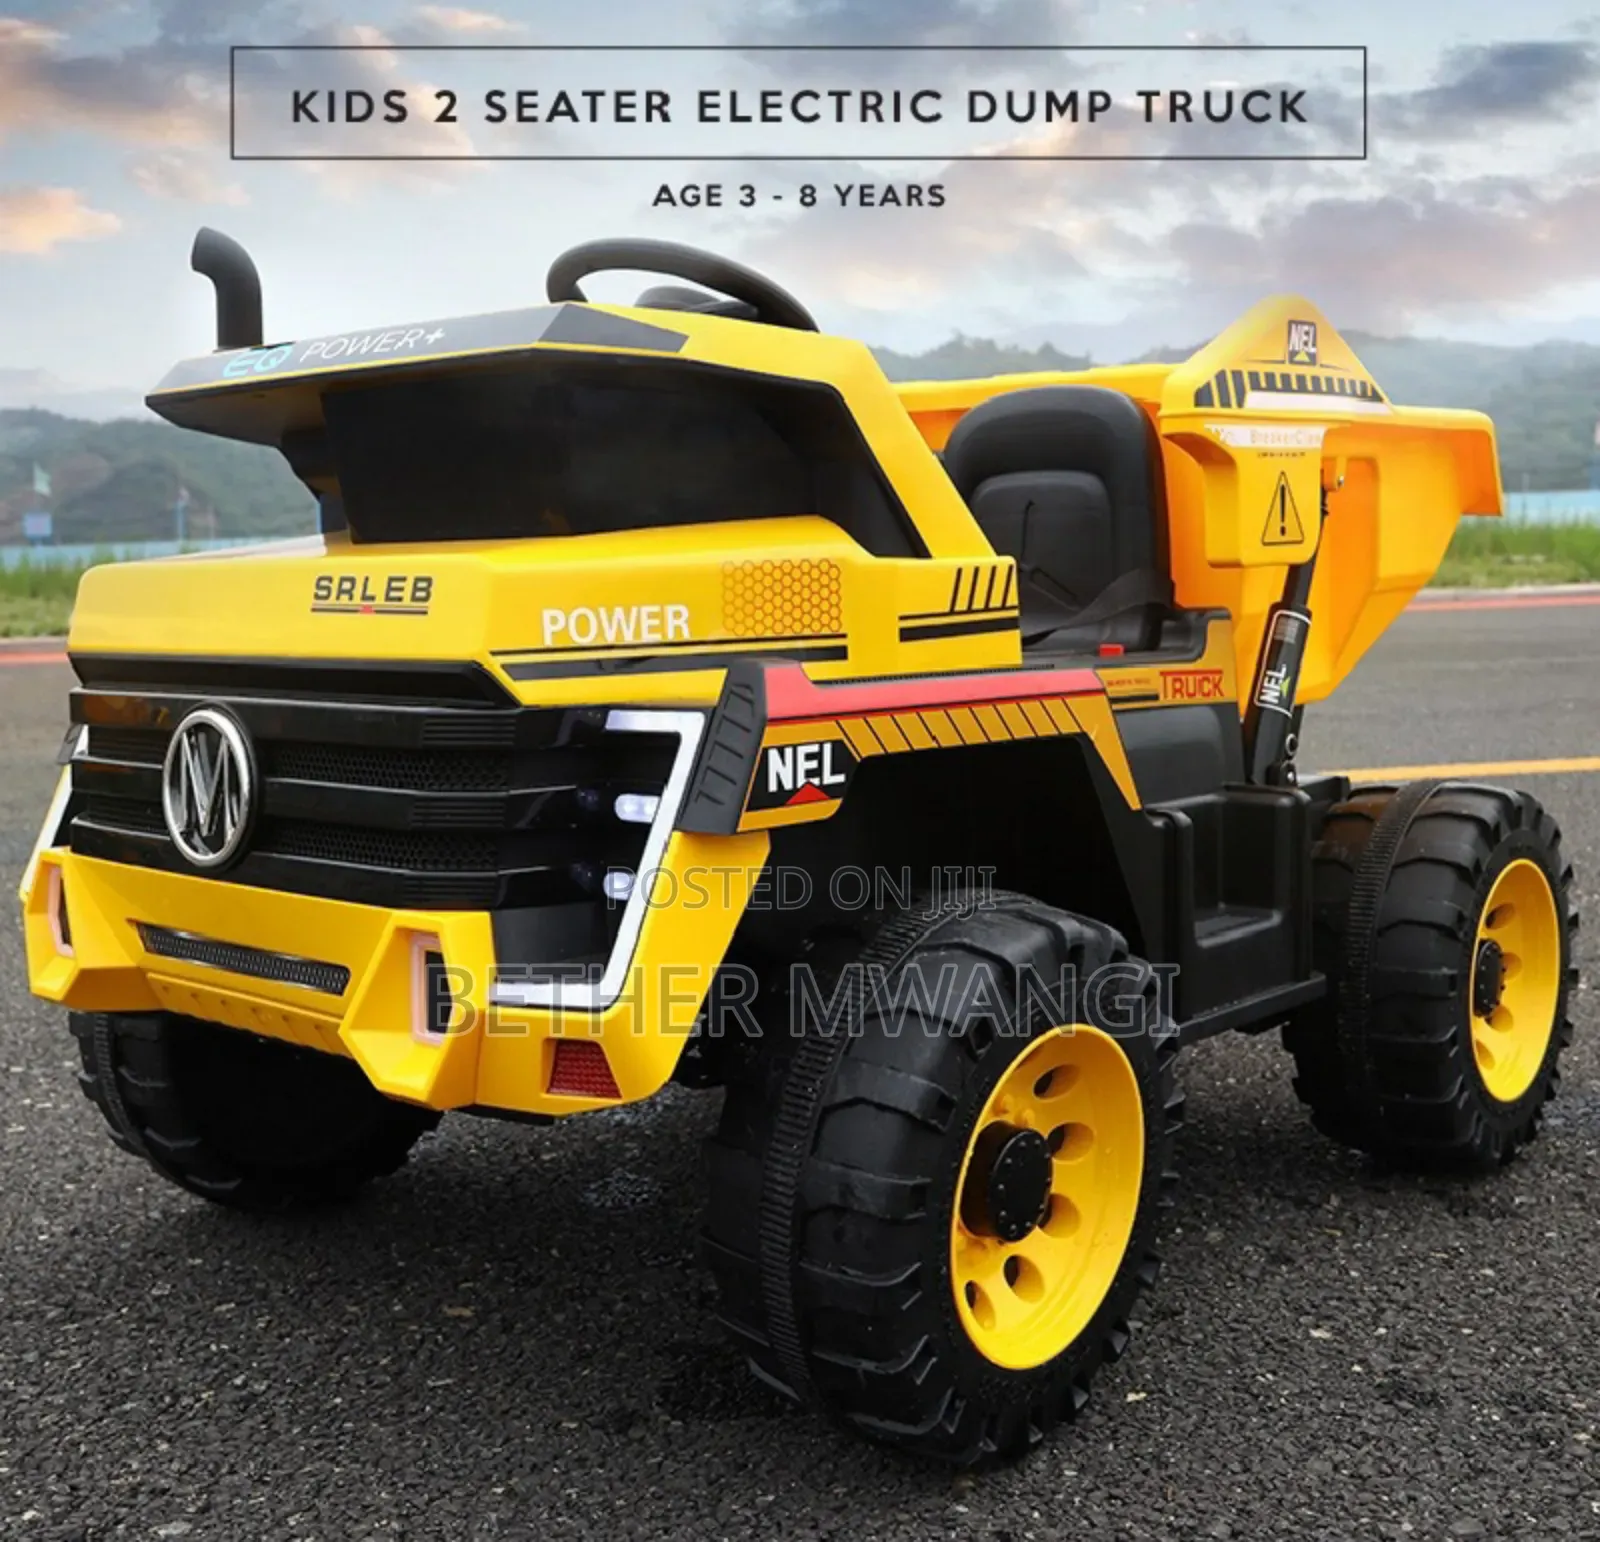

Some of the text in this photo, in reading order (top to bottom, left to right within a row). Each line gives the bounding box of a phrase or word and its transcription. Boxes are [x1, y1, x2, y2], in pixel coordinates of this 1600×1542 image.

[222, 327, 446, 378] EQ POWER+
[1288, 323, 1317, 353] NEL
[313, 575, 434, 603] SRLEB
[541, 604, 692, 646] POWER
[1159, 669, 1225, 700] TRUCK
[1259, 663, 1288, 705] NEL
[767, 742, 846, 793] NEL
